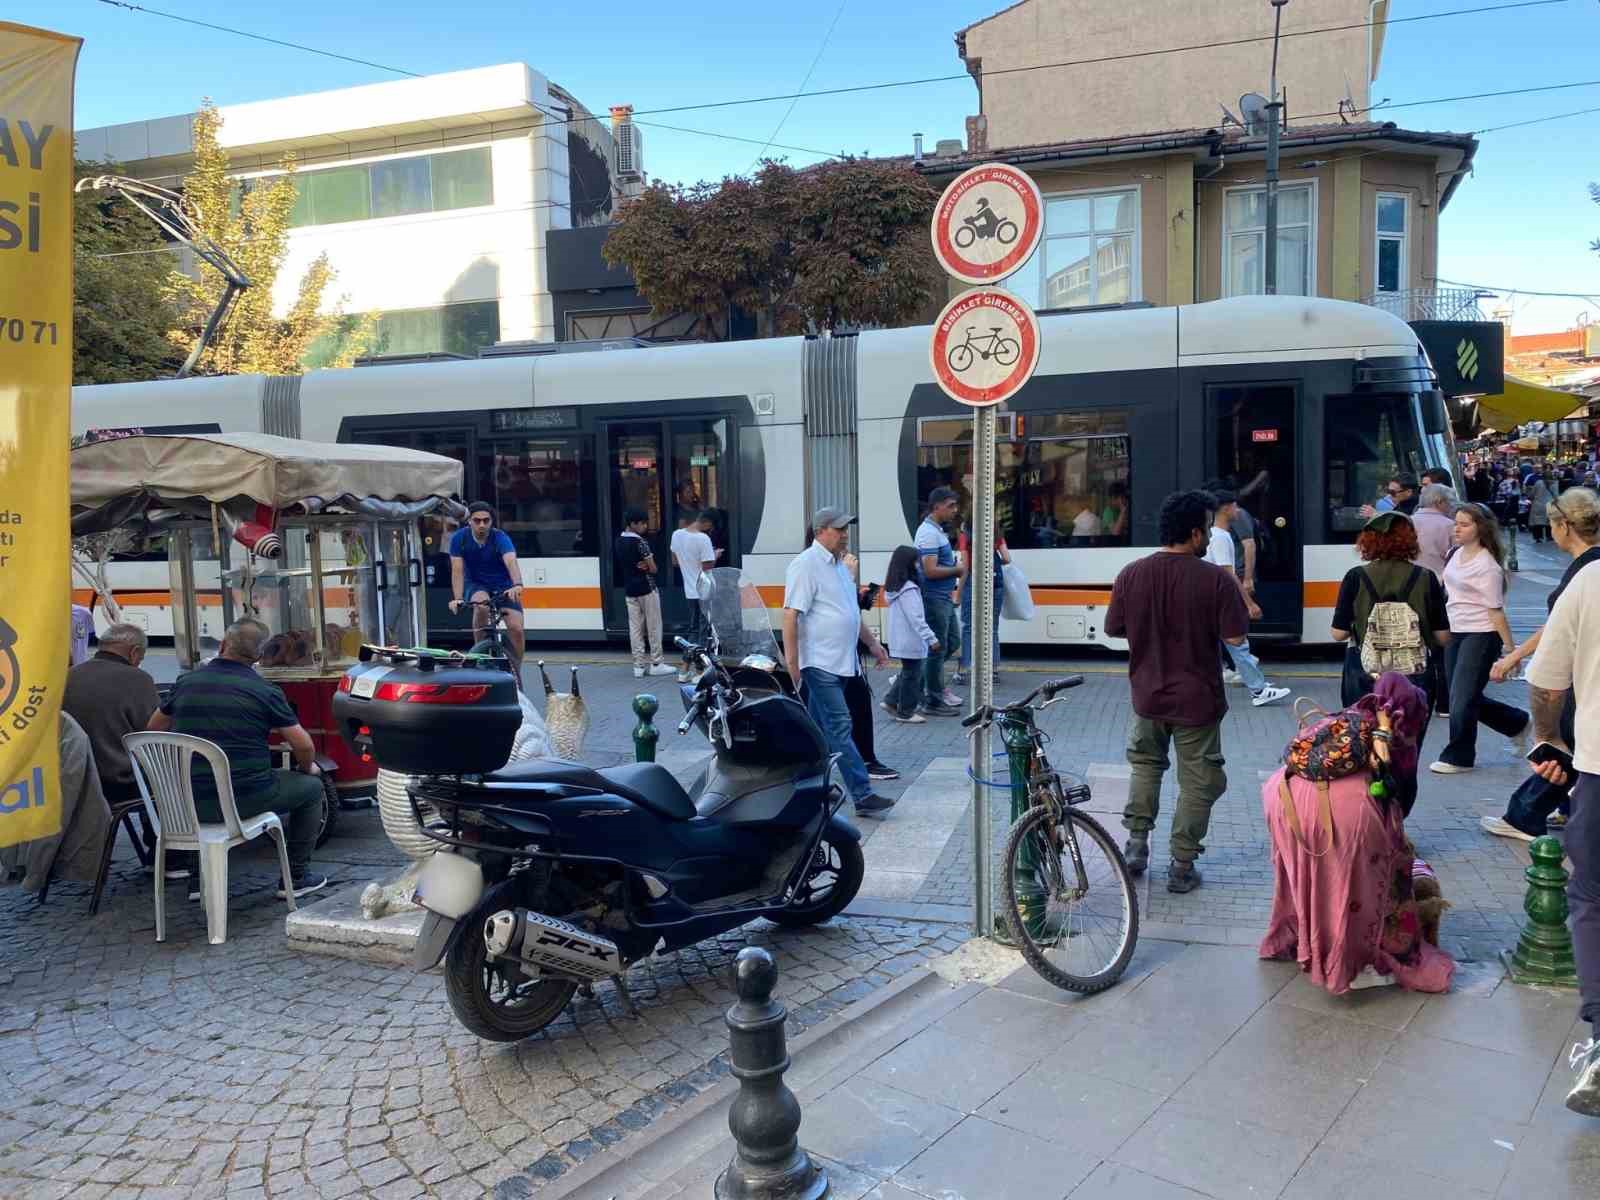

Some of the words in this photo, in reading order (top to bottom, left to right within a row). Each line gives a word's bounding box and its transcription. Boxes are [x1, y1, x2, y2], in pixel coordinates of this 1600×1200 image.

[31, 320, 57, 346] 71
[12, 684, 47, 730] dost
[535, 929, 616, 962] PCX
